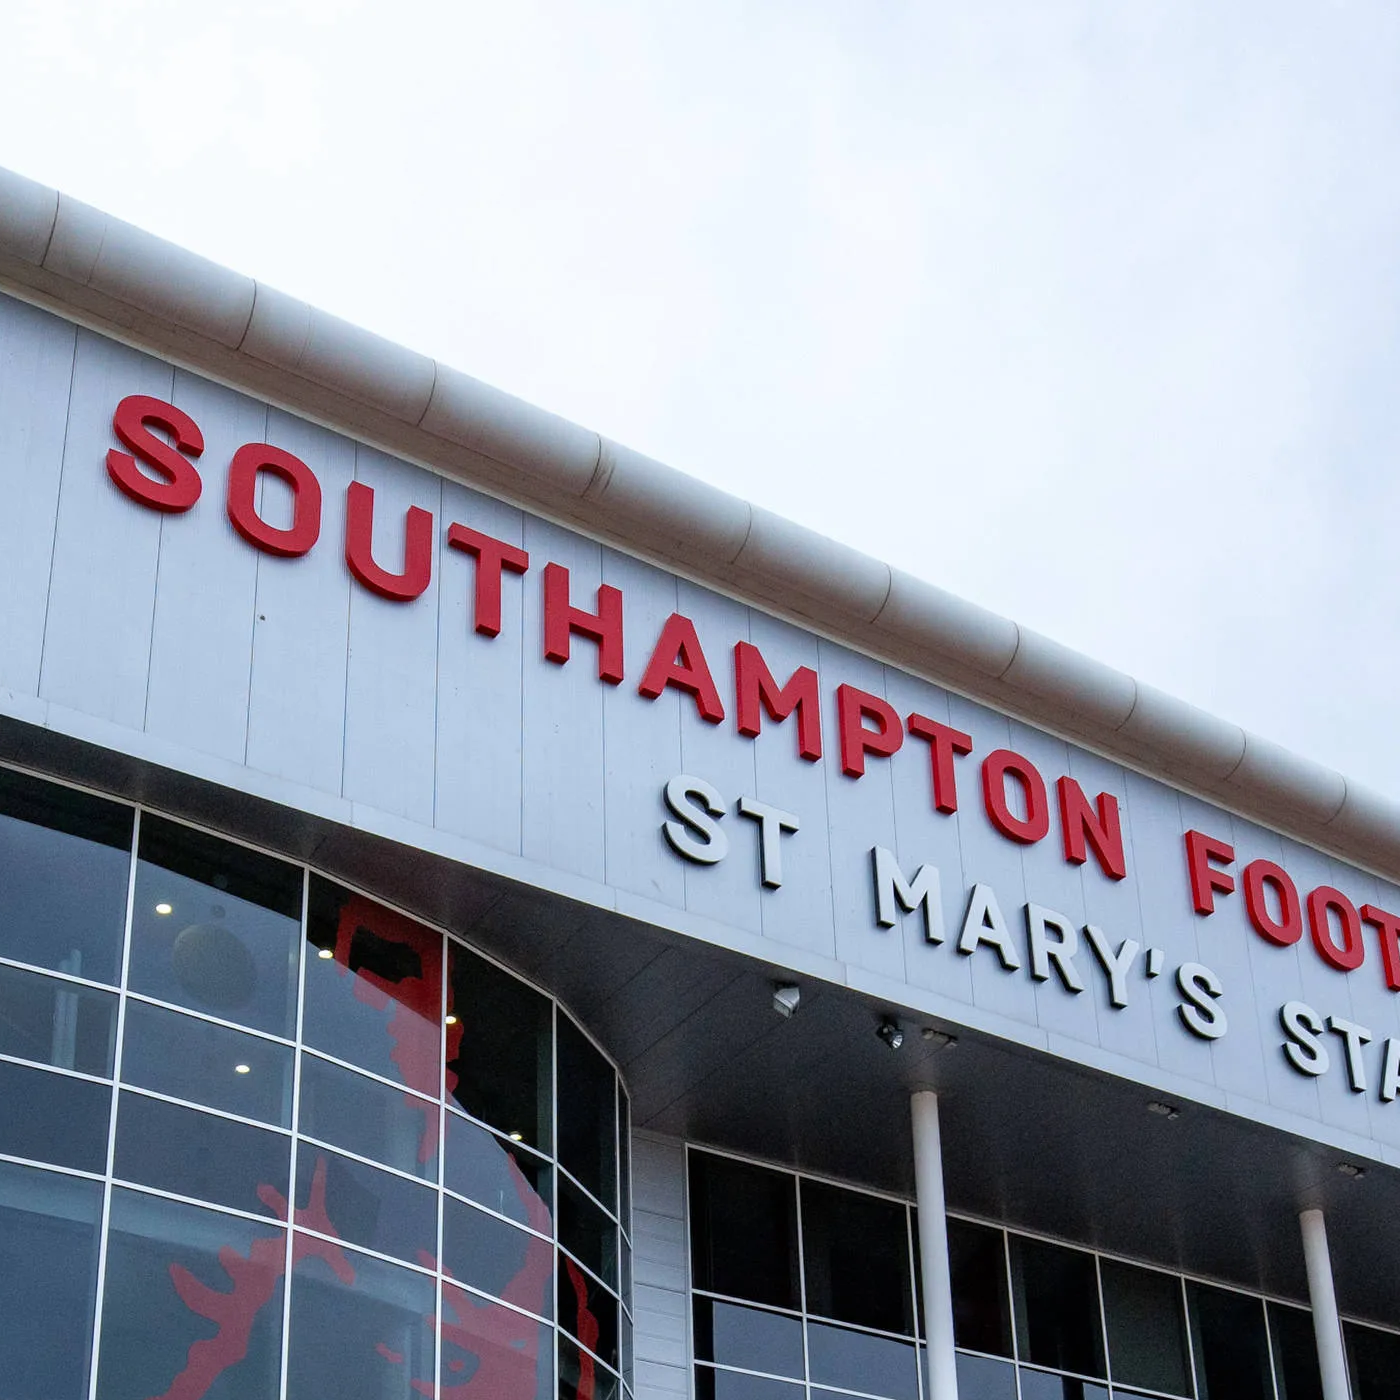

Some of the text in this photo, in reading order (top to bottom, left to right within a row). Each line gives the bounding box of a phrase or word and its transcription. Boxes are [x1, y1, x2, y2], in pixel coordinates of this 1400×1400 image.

[106, 395, 1127, 880] SOUTHAMPTON
[661, 774, 799, 891] ST
[870, 845, 1228, 1040] MARY'S
